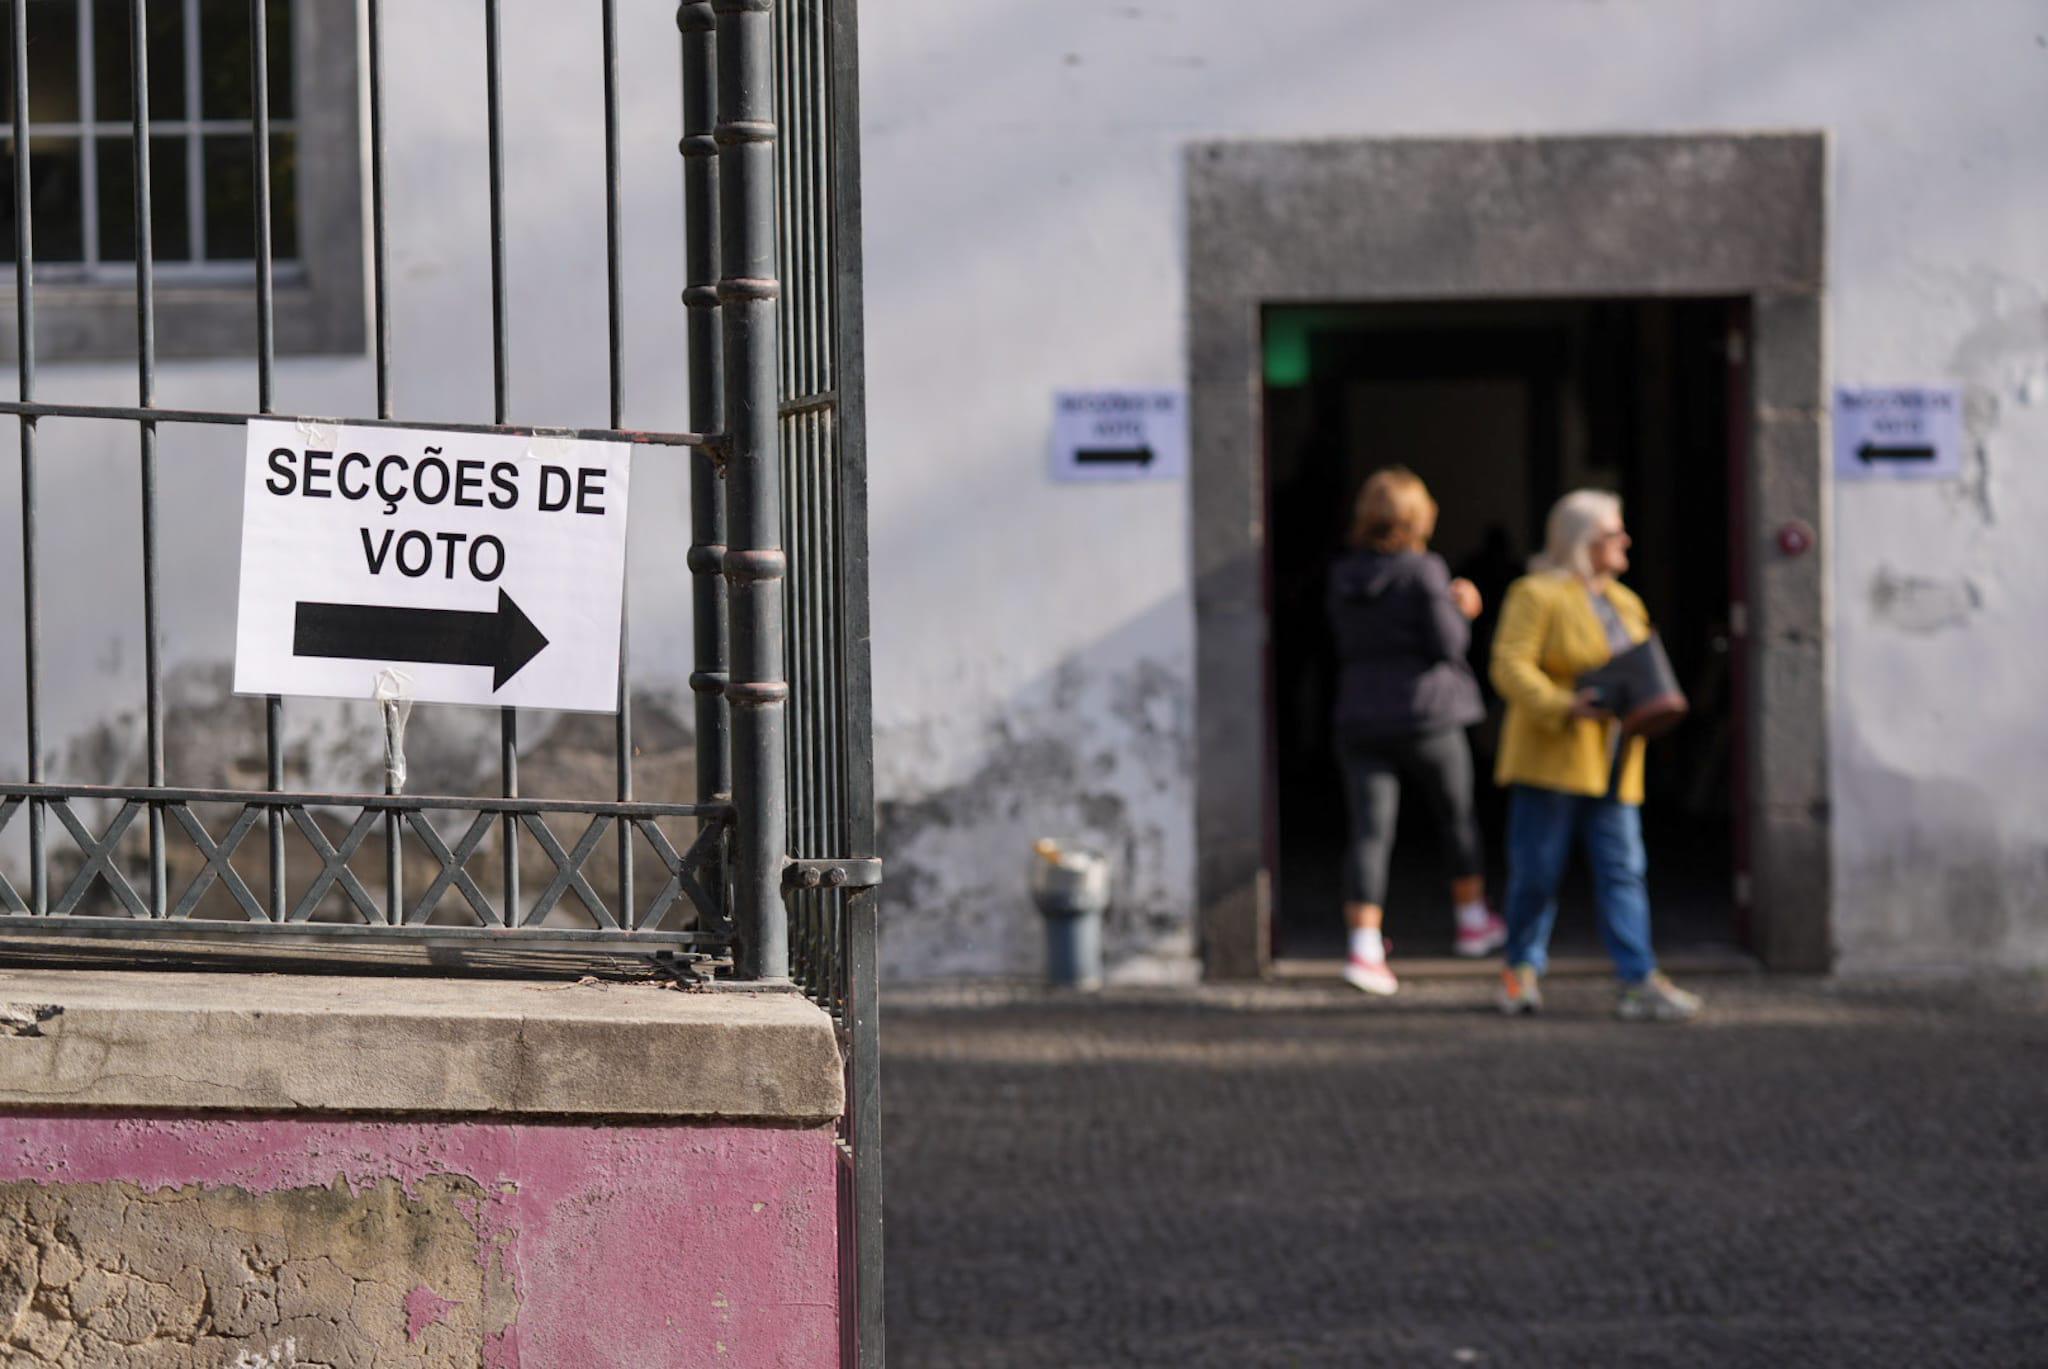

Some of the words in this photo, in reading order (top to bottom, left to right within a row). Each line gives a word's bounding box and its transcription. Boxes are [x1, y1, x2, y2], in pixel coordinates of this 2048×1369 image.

[265, 446, 520, 515] SECÇÕES
[538, 464, 608, 515] DE
[360, 527, 506, 582] VOTO
